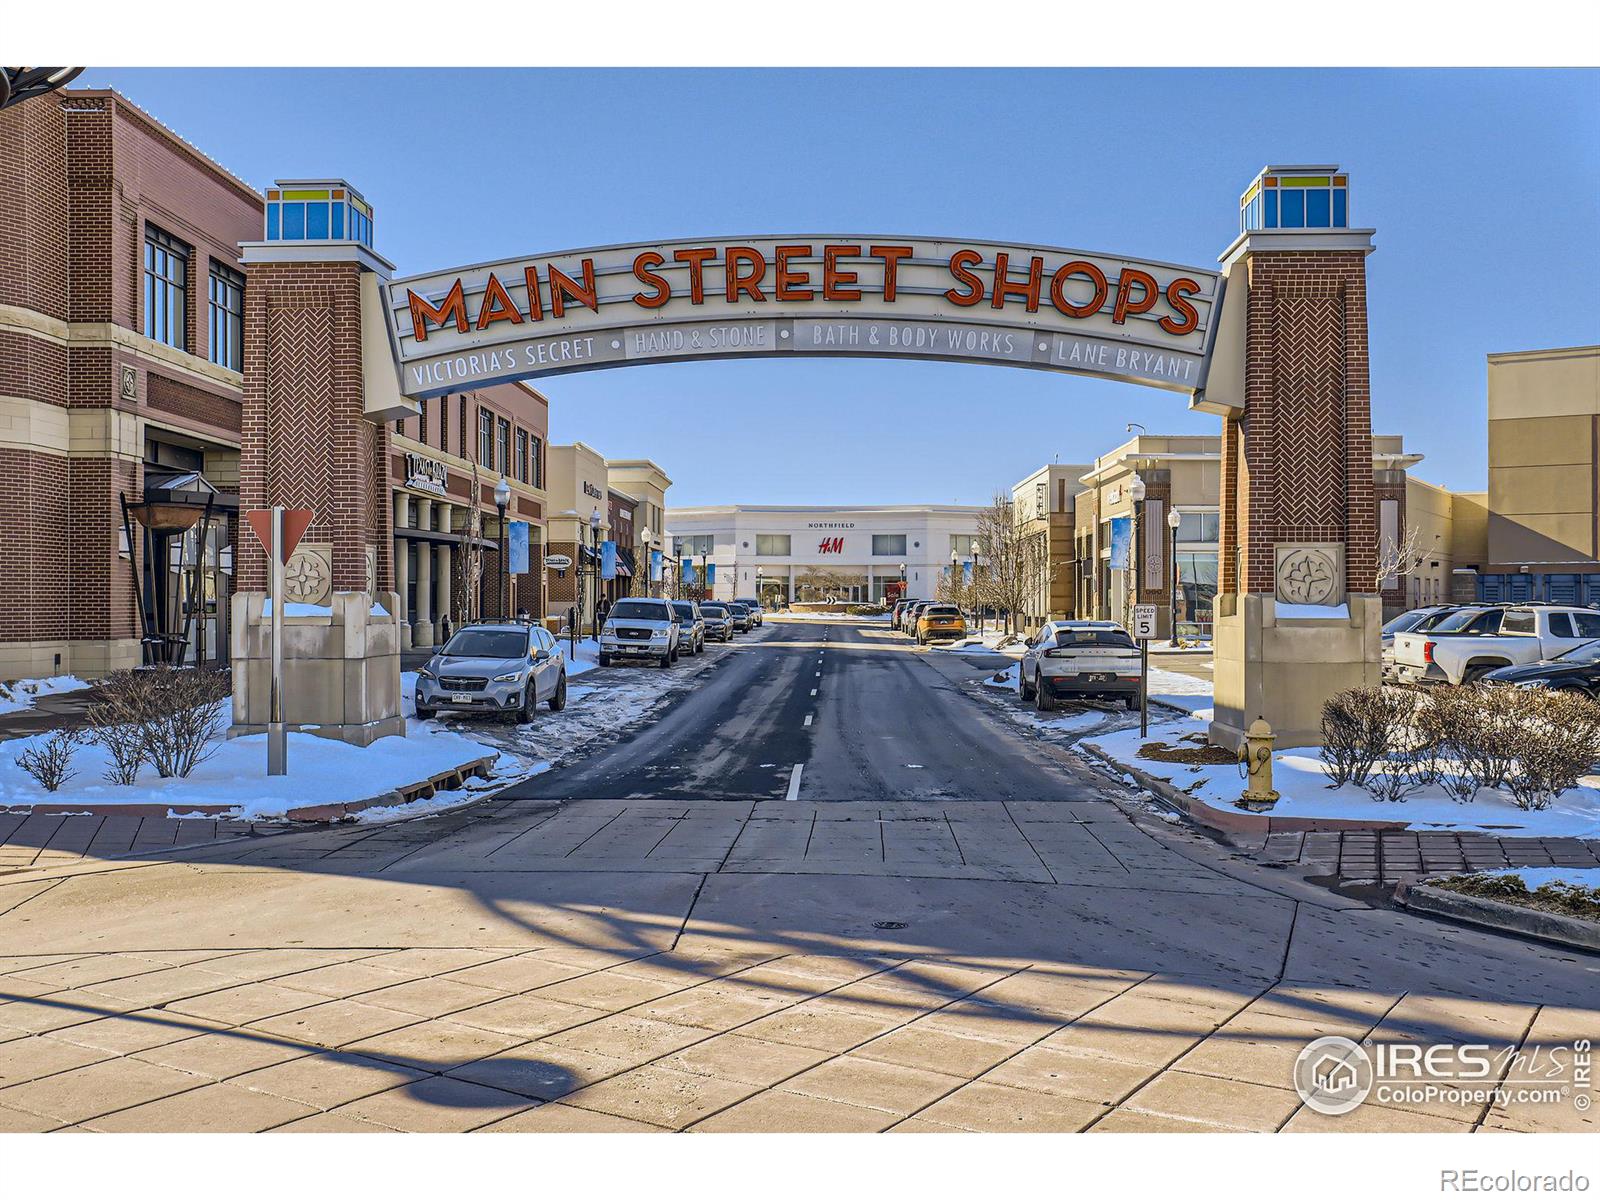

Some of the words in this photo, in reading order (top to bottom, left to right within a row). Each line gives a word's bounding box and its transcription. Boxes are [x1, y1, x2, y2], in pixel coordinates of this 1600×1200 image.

[406, 258, 599, 342] MAIN
[632, 245, 914, 308] STREET
[944, 249, 1202, 336] SHOPS
[635, 330, 685, 354] HAND
[690, 328, 703, 348] &
[709, 325, 765, 348] STONE
[812, 325, 860, 346] BATH
[868, 326, 880, 346] &
[889, 327, 939, 349] BODY
[948, 329, 1015, 354] WORKS
[412, 347, 517, 386] VICTORIA'S
[525, 337, 595, 365] SECRET
[1058, 340, 1108, 366] LANE
[1115, 347, 1194, 381] BRYANT
[818, 537, 844, 554] H&M
[1140, 621, 1150, 634] 5
